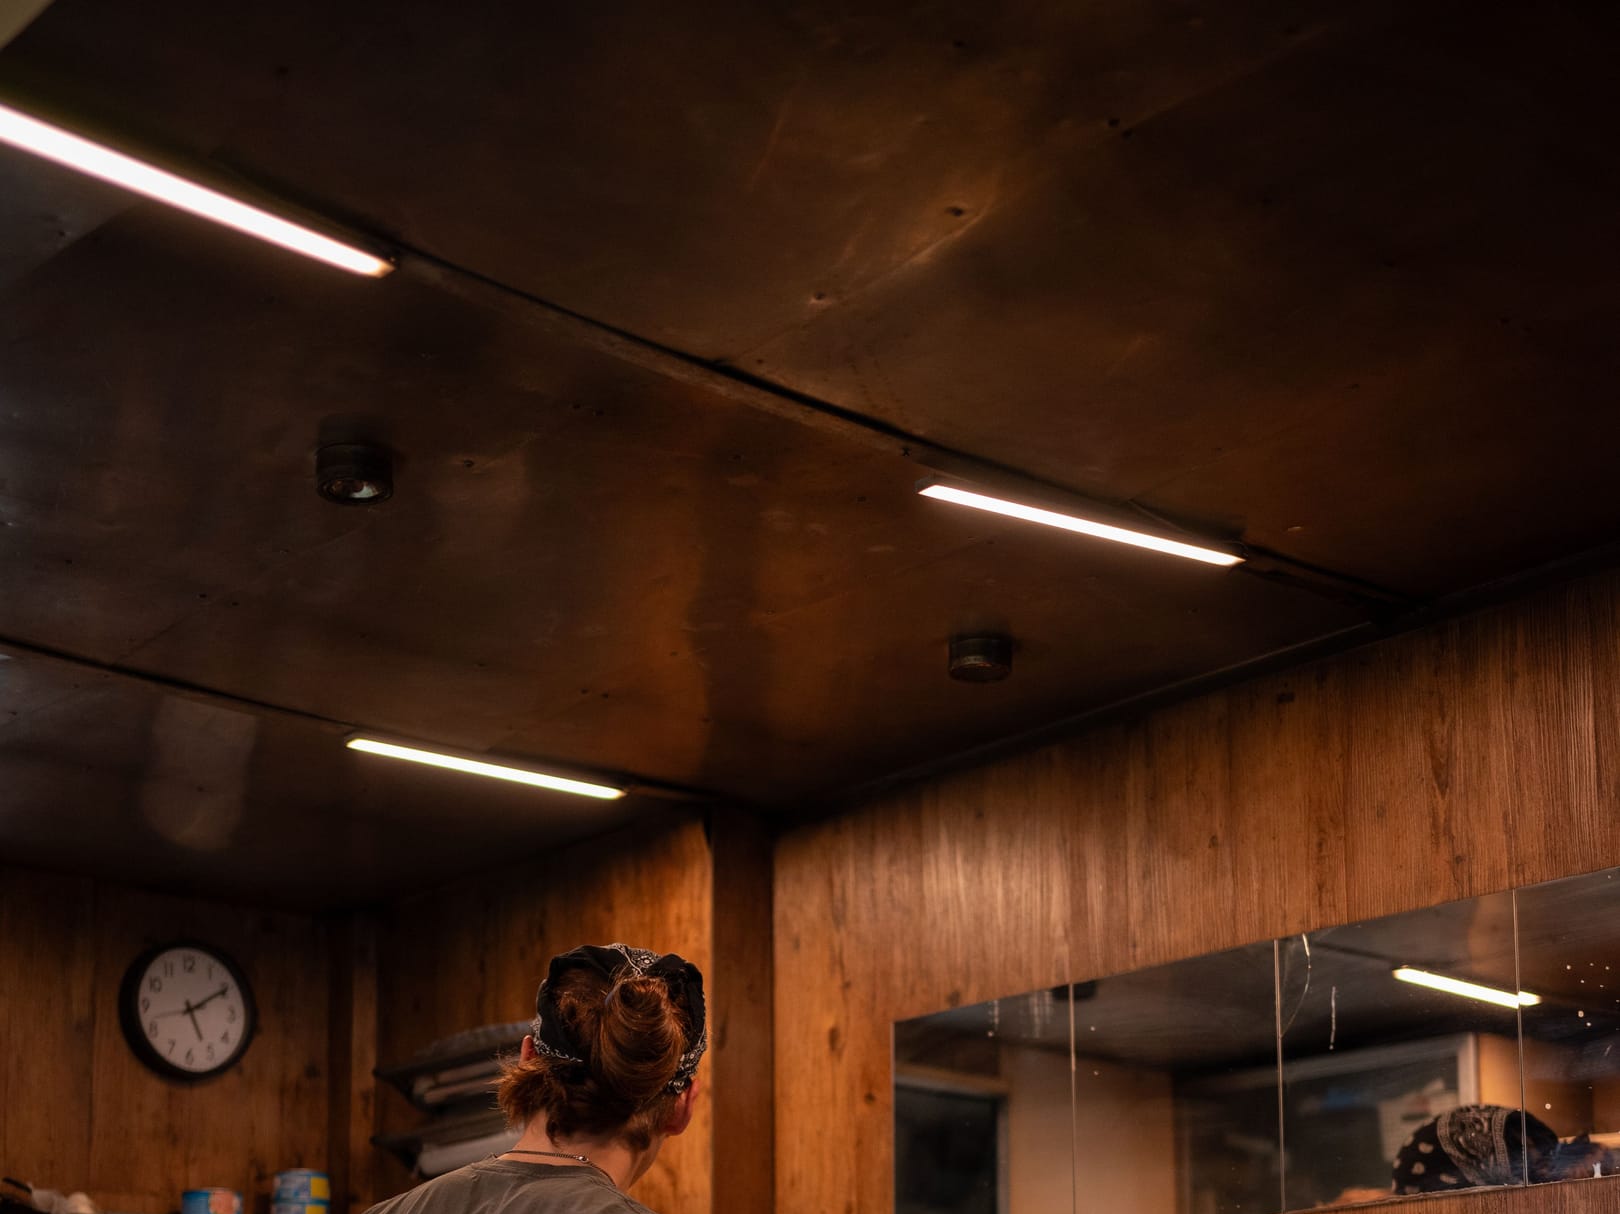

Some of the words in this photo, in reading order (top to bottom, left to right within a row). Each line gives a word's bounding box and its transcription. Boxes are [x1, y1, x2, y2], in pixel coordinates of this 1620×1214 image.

[164, 961, 173, 978] 11
[183, 956, 195, 973] 12
[208, 963, 213, 980] 1
[149, 976, 162, 993] 10
[142, 997, 150, 1013] 9
[227, 1005, 236, 1024] 3
[149, 1021, 158, 1038] 8
[220, 1029, 229, 1043] 4
[168, 1038, 176, 1055] 7
[185, 1048, 194, 1065] 6
